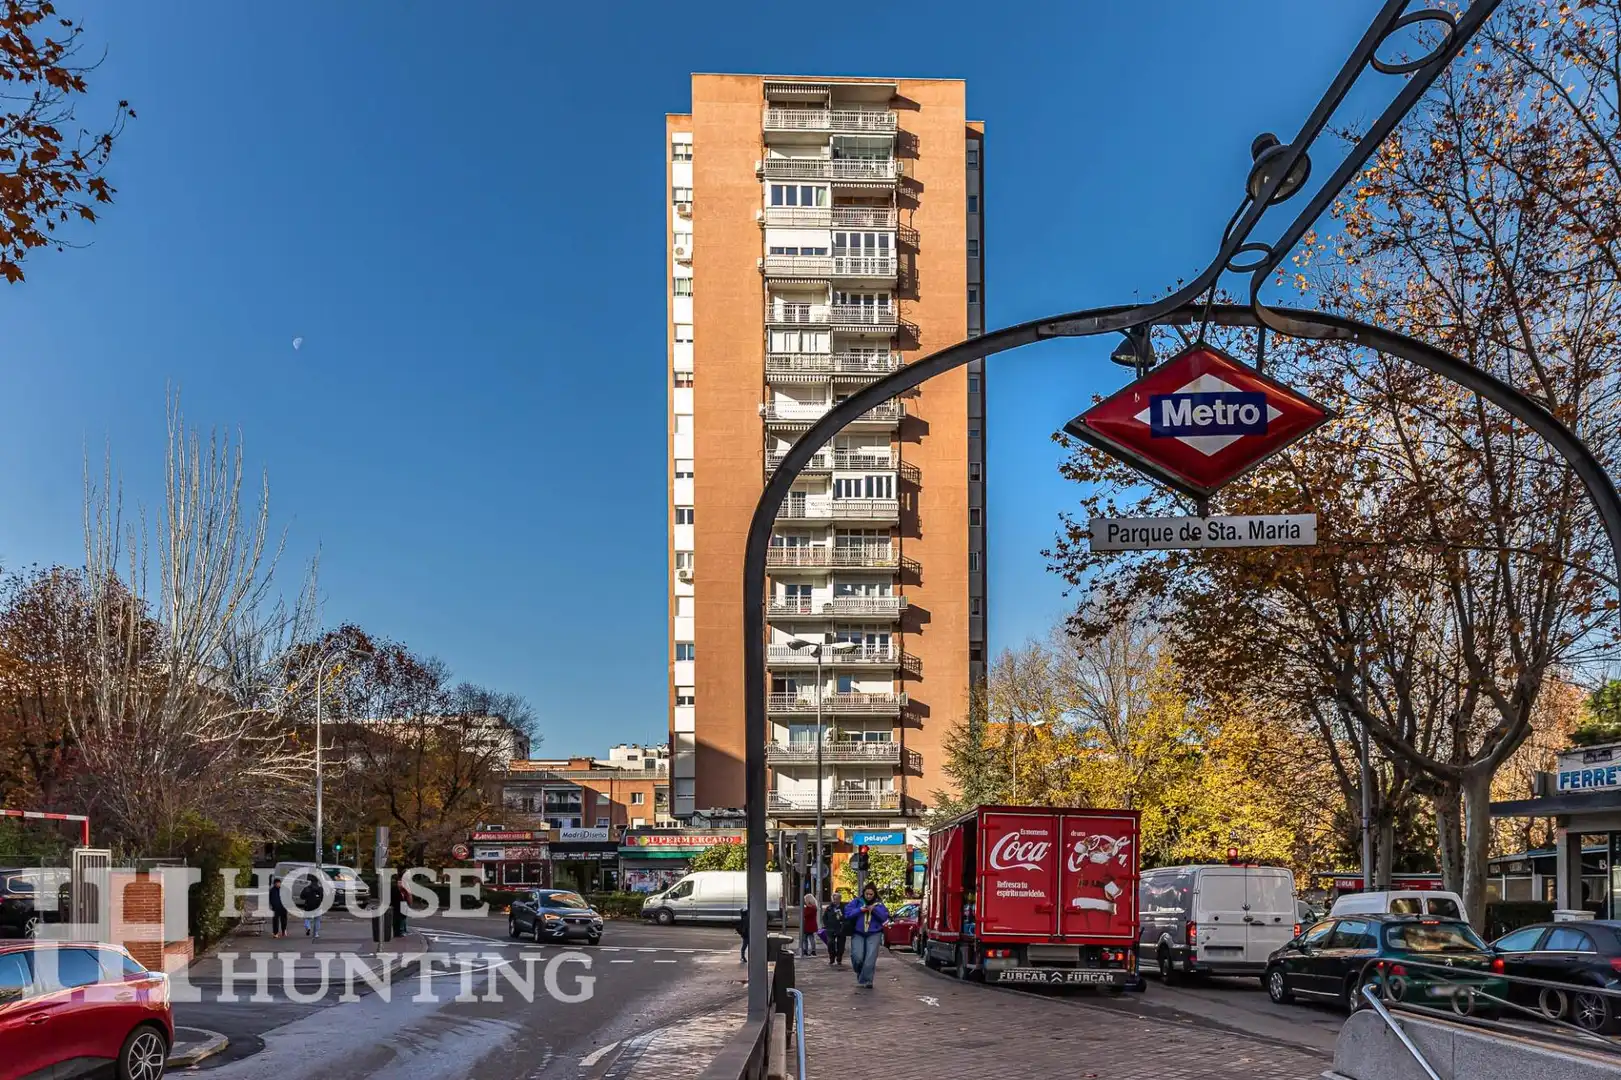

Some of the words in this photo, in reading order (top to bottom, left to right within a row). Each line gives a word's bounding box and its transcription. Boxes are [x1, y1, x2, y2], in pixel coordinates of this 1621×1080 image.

[1162, 398, 1260, 427] Metro
[1108, 523, 1173, 547] Parque
[1179, 522, 1202, 542] de
[1207, 520, 1242, 541] Sta.
[1248, 519, 1300, 540] María
[1559, 766, 1621, 790] FERRE
[864, 834, 888, 842] pelayo
[1000, 972, 1047, 981] FURCAR
[1067, 973, 1114, 982] FURCAR
